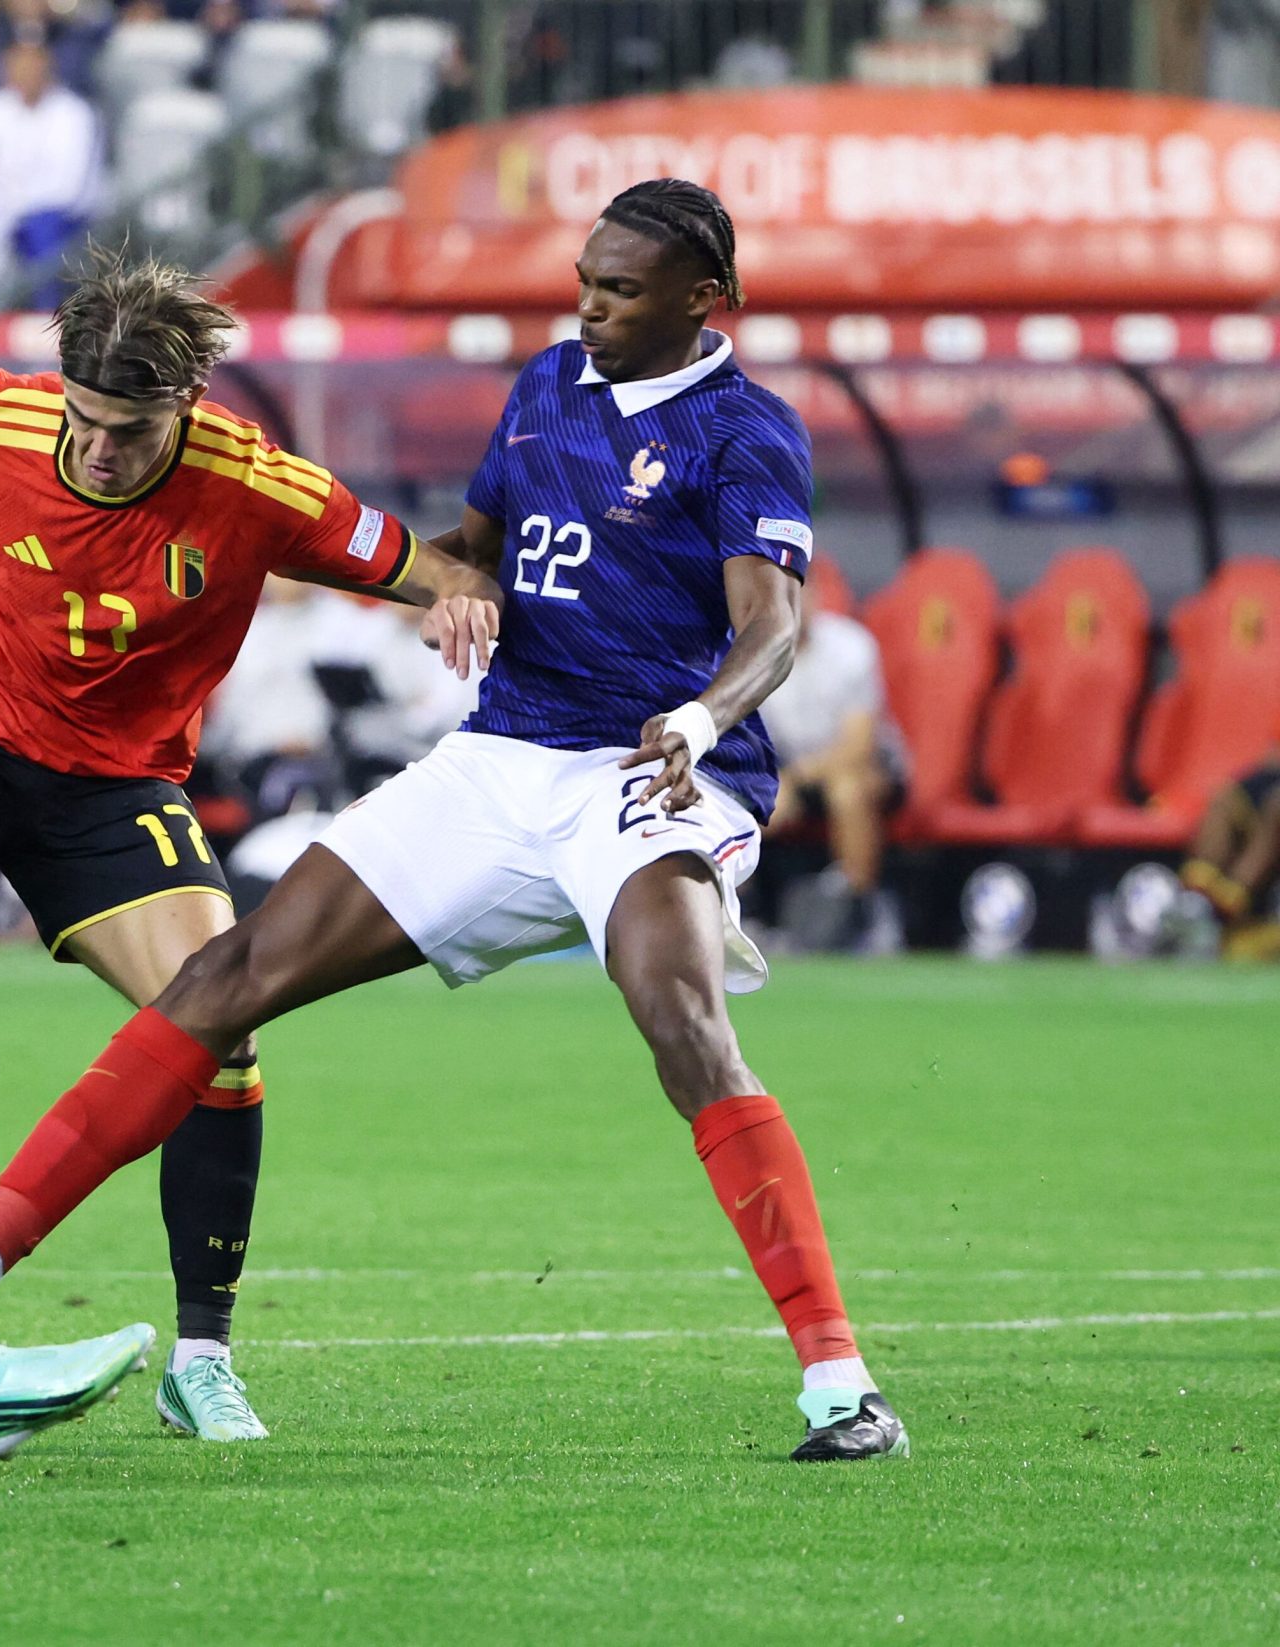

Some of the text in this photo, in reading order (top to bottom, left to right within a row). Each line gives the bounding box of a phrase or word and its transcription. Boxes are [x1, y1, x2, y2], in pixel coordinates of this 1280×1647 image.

[721, 132, 815, 220] OF
[826, 134, 1216, 222] BRUSSELS
[513, 514, 591, 600] 22
[63, 591, 137, 657] 17
[136, 803, 211, 867] 17
